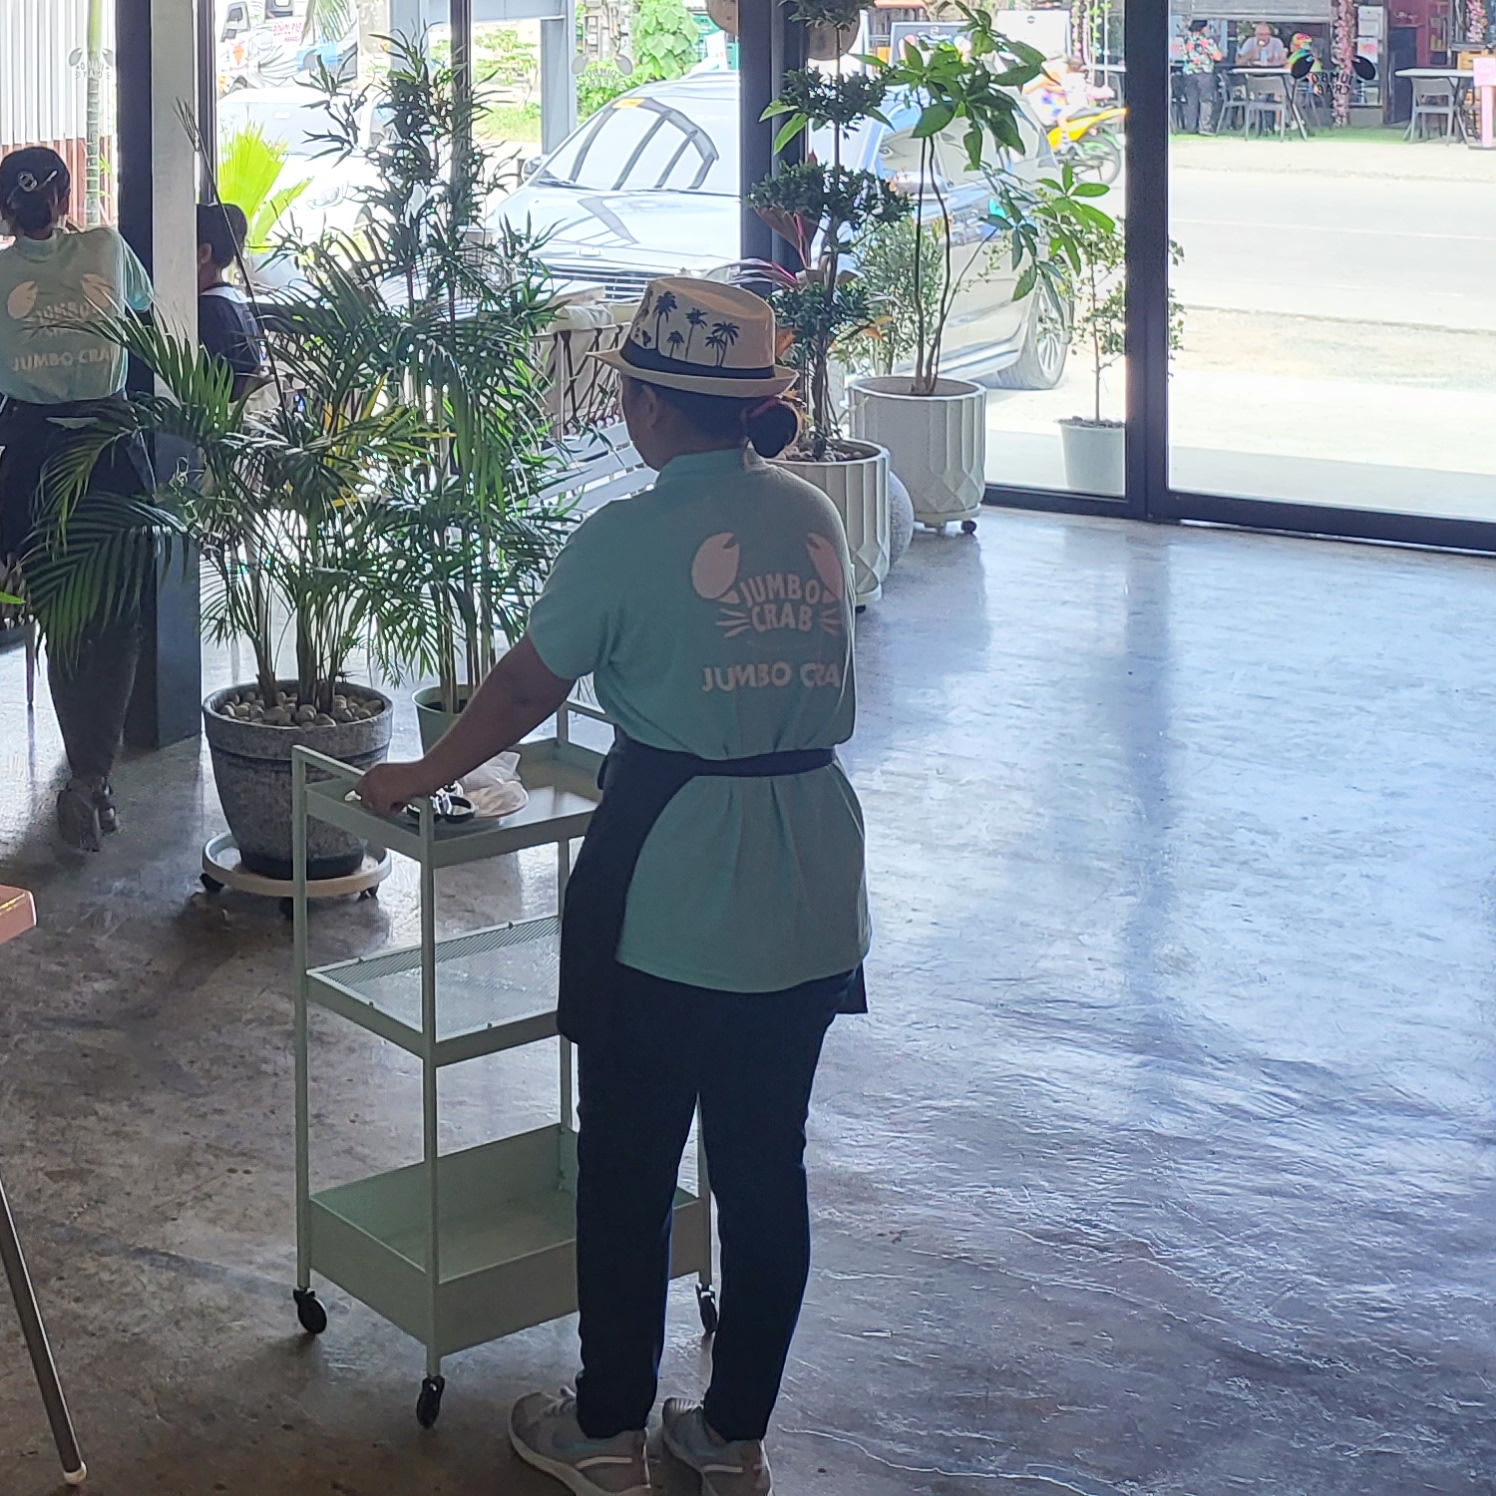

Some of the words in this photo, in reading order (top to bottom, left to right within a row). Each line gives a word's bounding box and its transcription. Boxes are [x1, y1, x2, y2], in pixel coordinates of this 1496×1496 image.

[12, 351, 74, 372] JUMBO
[739, 573, 822, 608] JUMBO
[751, 603, 813, 632] CRAB
[702, 661, 792, 692] JUMBO
[800, 662, 842, 689] CRA
